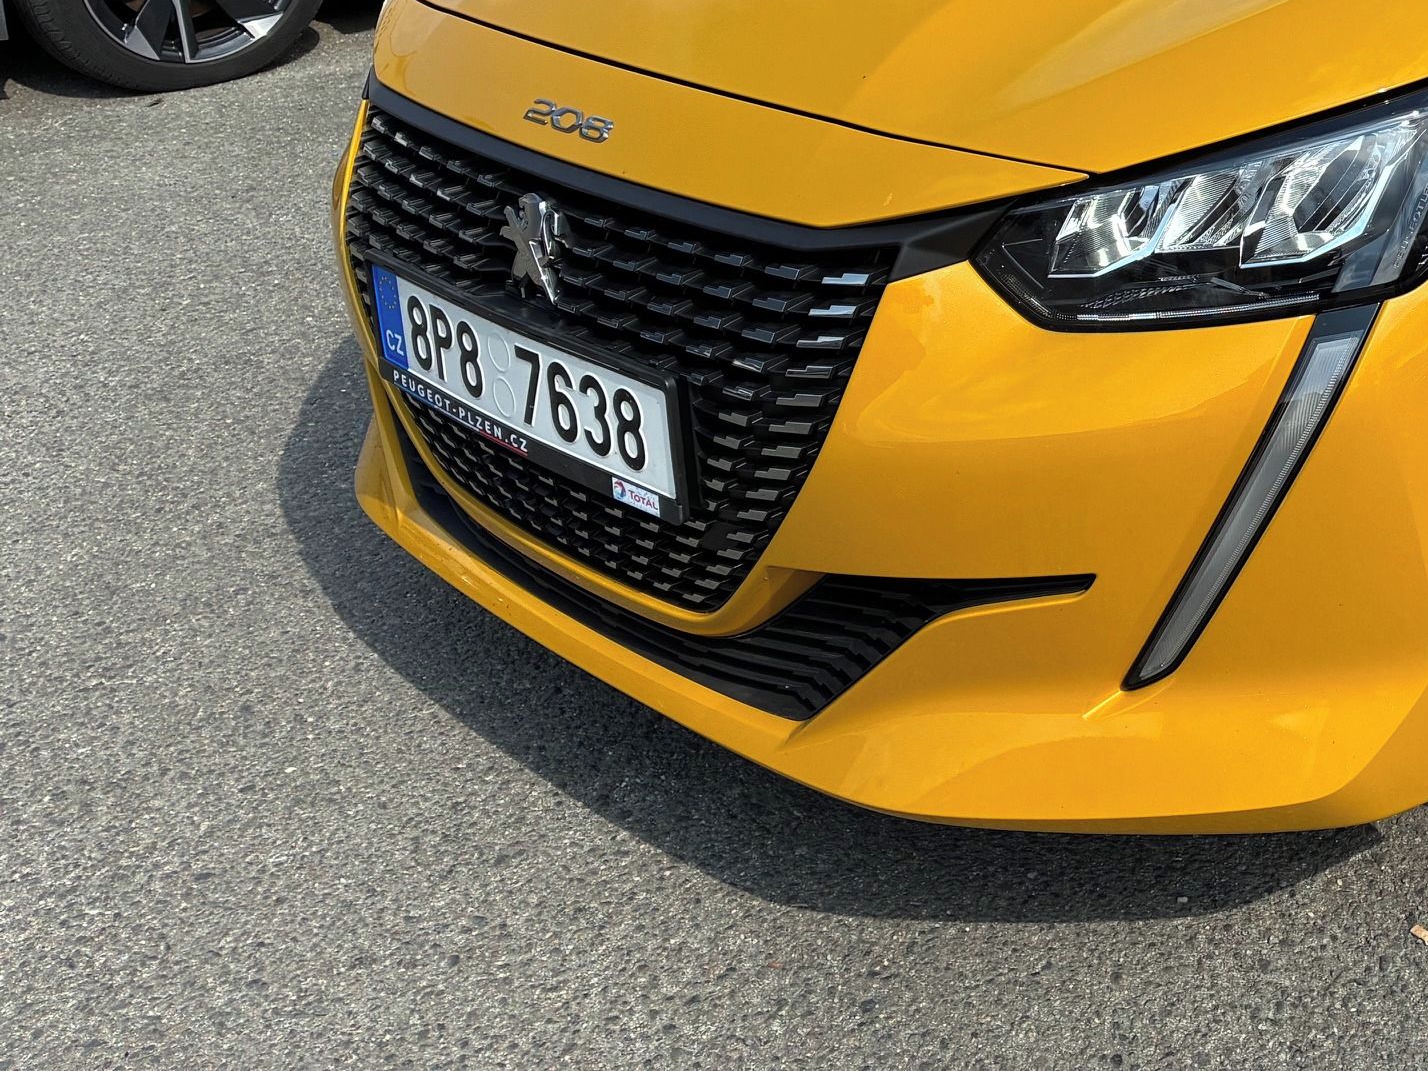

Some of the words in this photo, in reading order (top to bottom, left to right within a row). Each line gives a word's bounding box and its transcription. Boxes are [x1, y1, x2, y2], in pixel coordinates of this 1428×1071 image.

[522, 98, 614, 144] 208
[385, 329, 405, 357] CZ
[406, 295, 485, 399] 8P8
[513, 343, 648, 472] 7638
[627, 489, 659, 511] TOTAL
